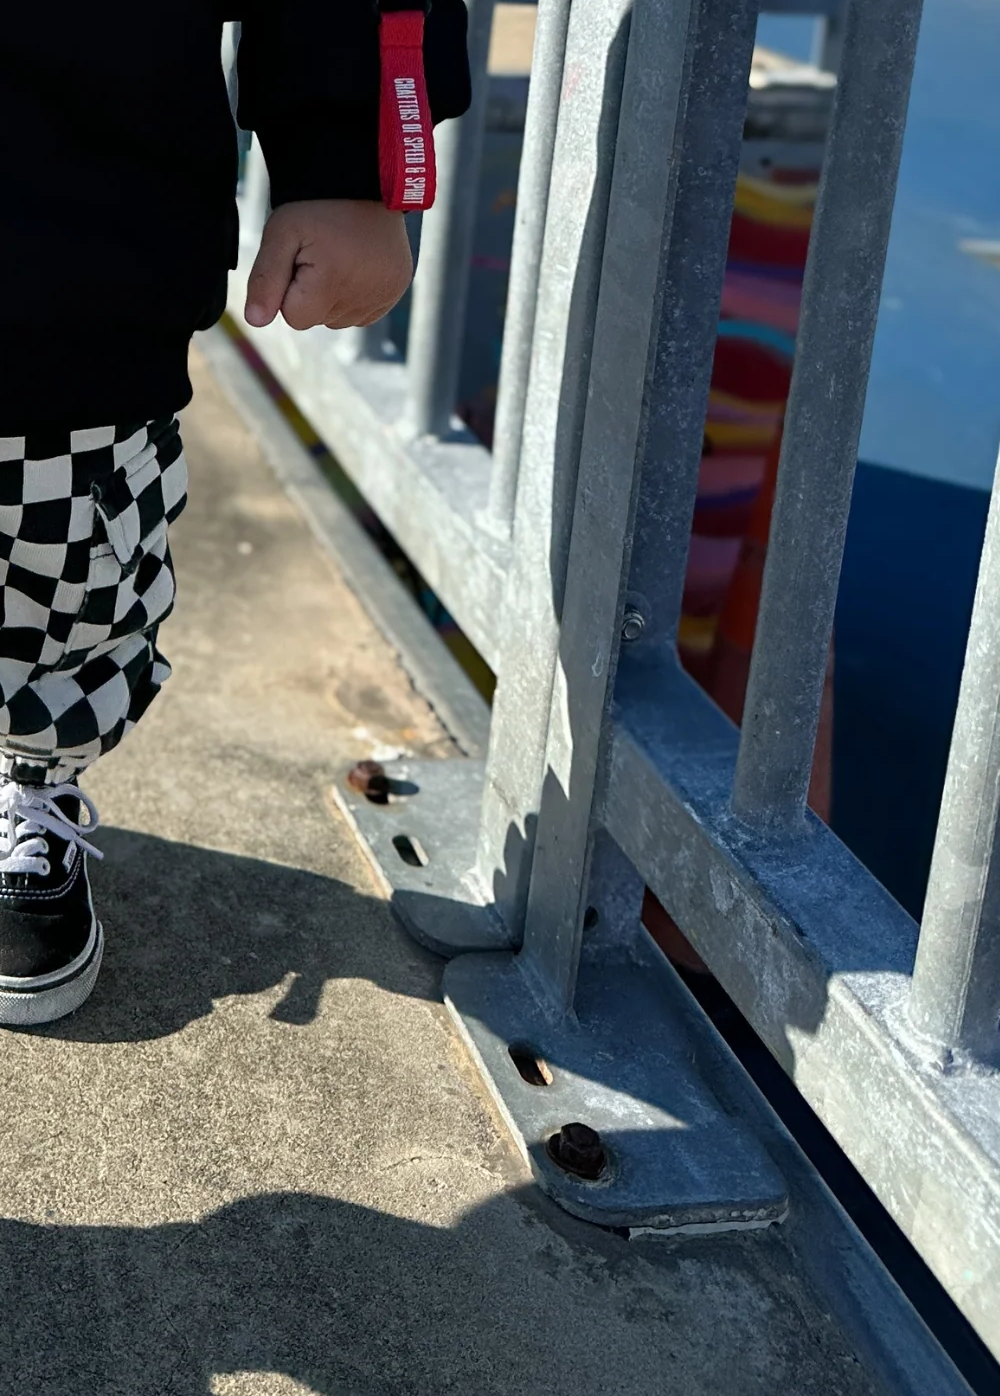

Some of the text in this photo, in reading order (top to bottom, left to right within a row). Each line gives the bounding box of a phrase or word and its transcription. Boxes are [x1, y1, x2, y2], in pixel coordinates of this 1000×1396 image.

[394, 77, 420, 121] CRAFTERS
[402, 124, 422, 133] OF
[404, 137, 426, 164] SPEED
[402, 177, 426, 205] SPIRIT
